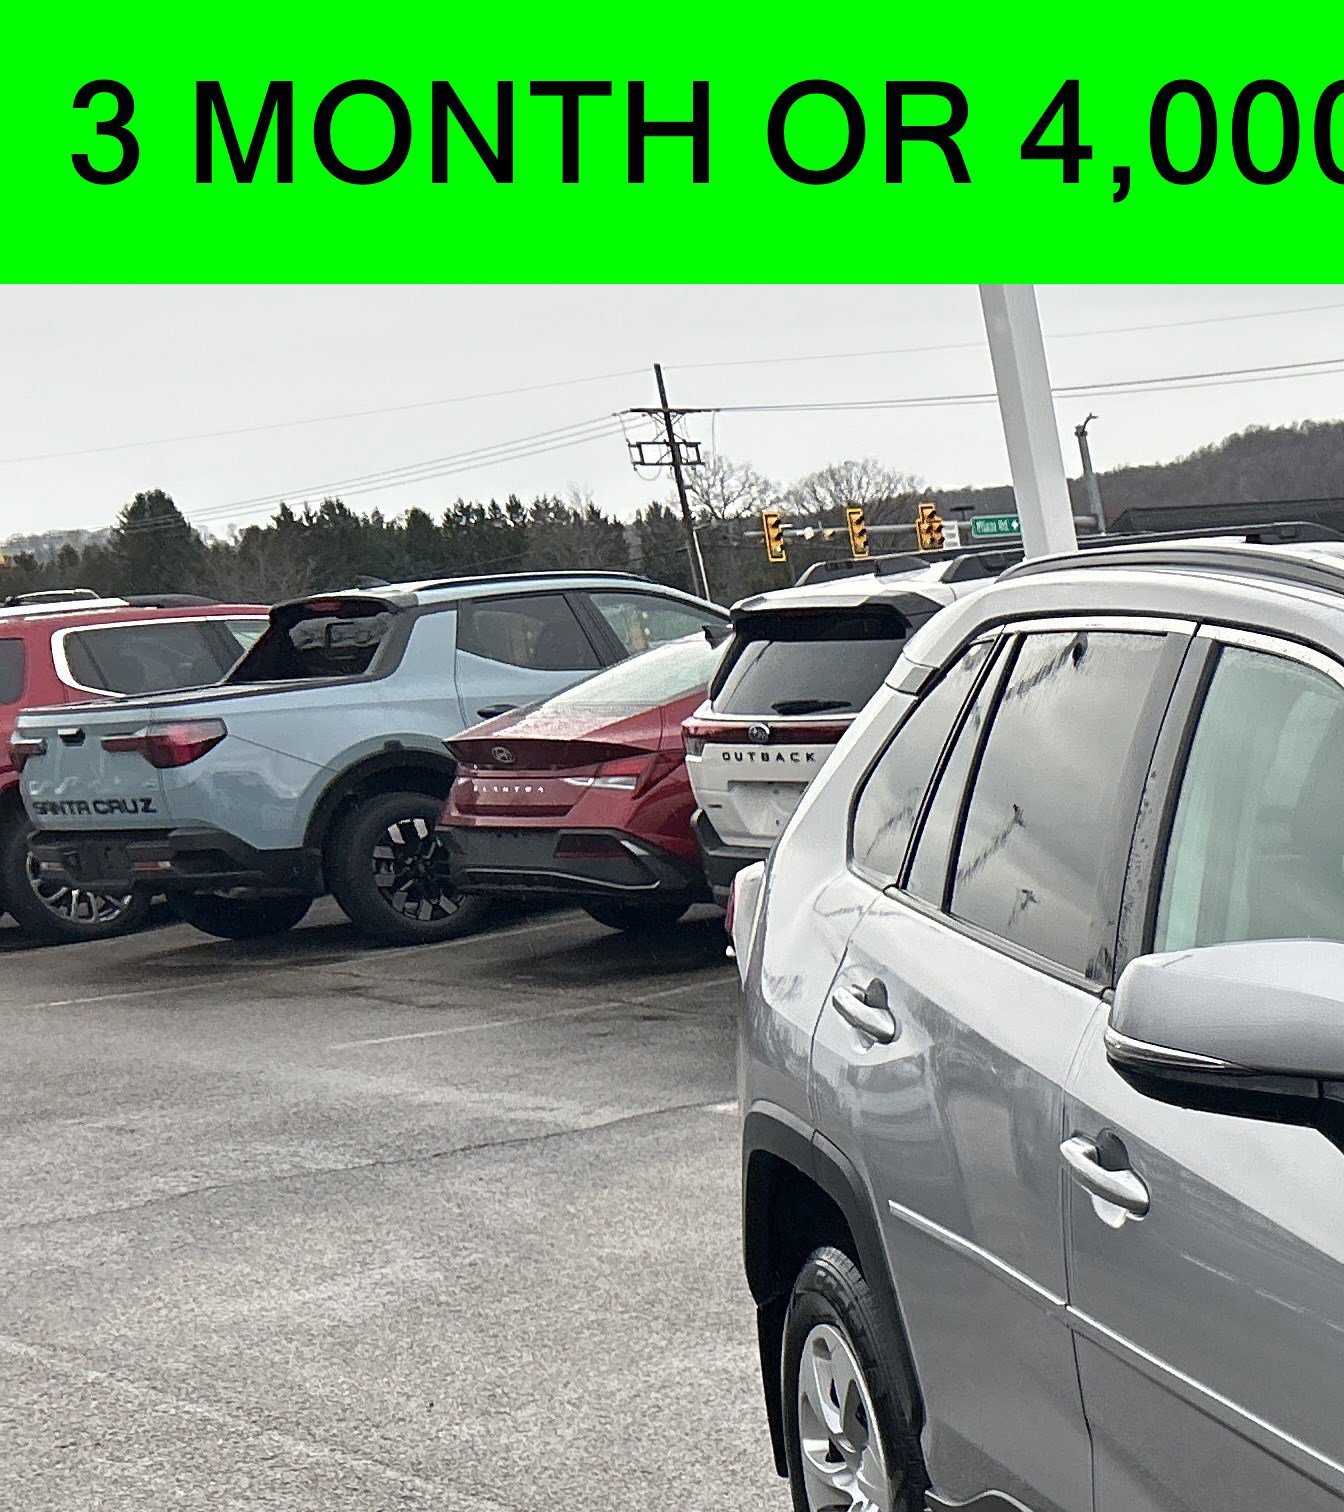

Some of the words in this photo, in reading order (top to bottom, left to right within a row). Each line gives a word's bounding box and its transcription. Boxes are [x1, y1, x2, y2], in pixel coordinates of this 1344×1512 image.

[721, 751, 816, 763] OUTBACK
[32, 800, 92, 816] SANTA
[93, 798, 158, 815] CRUZ
